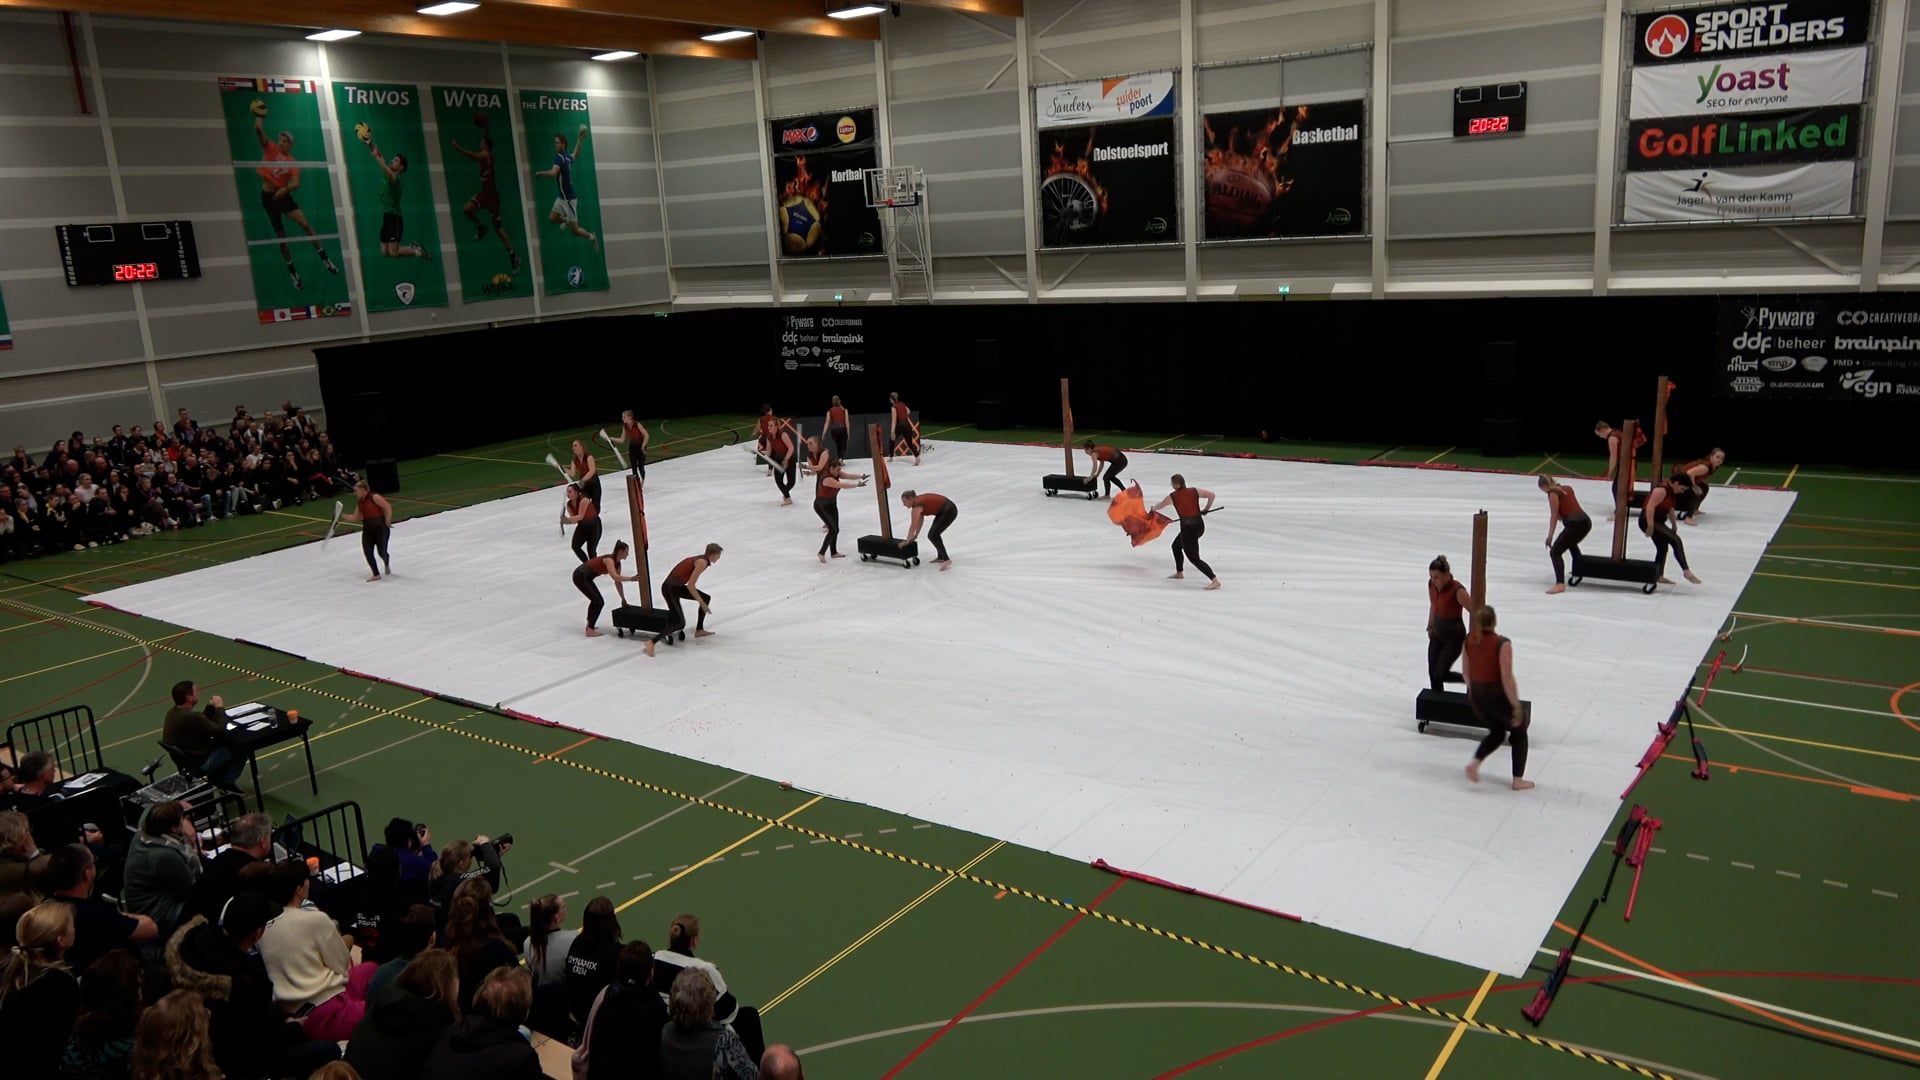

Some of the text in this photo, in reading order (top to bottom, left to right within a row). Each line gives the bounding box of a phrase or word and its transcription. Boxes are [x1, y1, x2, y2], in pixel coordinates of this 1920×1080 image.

[1695, 3, 1788, 33] SPORT
[1700, 17, 1845, 52] SNELDERS
[1696, 63, 1790, 104] yoast
[344, 86, 410, 105] TRIVOS
[443, 90, 501, 108] WYBA
[539, 96, 587, 111] FLYERS
[1116, 88, 1142, 106] zuider
[1130, 94, 1153, 114] poort
[1706, 94, 1788, 108] SEO for everyone
[1046, 96, 1094, 117] Sanders
[1470, 117, 1509, 133] 20:22
[1292, 125, 1358, 145] Basketbal
[1639, 114, 1848, 158] GolfLinked
[1093, 141, 1168, 161] Rolstoelsport
[1676, 191, 1793, 207] Jager van der Kamp
[115, 264, 156, 280] 20:22
[791, 315, 814, 330] Pyware
[1759, 307, 1815, 330] Pyware
[782, 331, 798, 345] ddf
[822, 333, 864, 344] brainpink
[1733, 331, 1826, 354] ddf beheer
[834, 362, 849, 373] cgn
[1833, 359, 1853, 367] PMD
[1854, 381, 1892, 398] cgn
